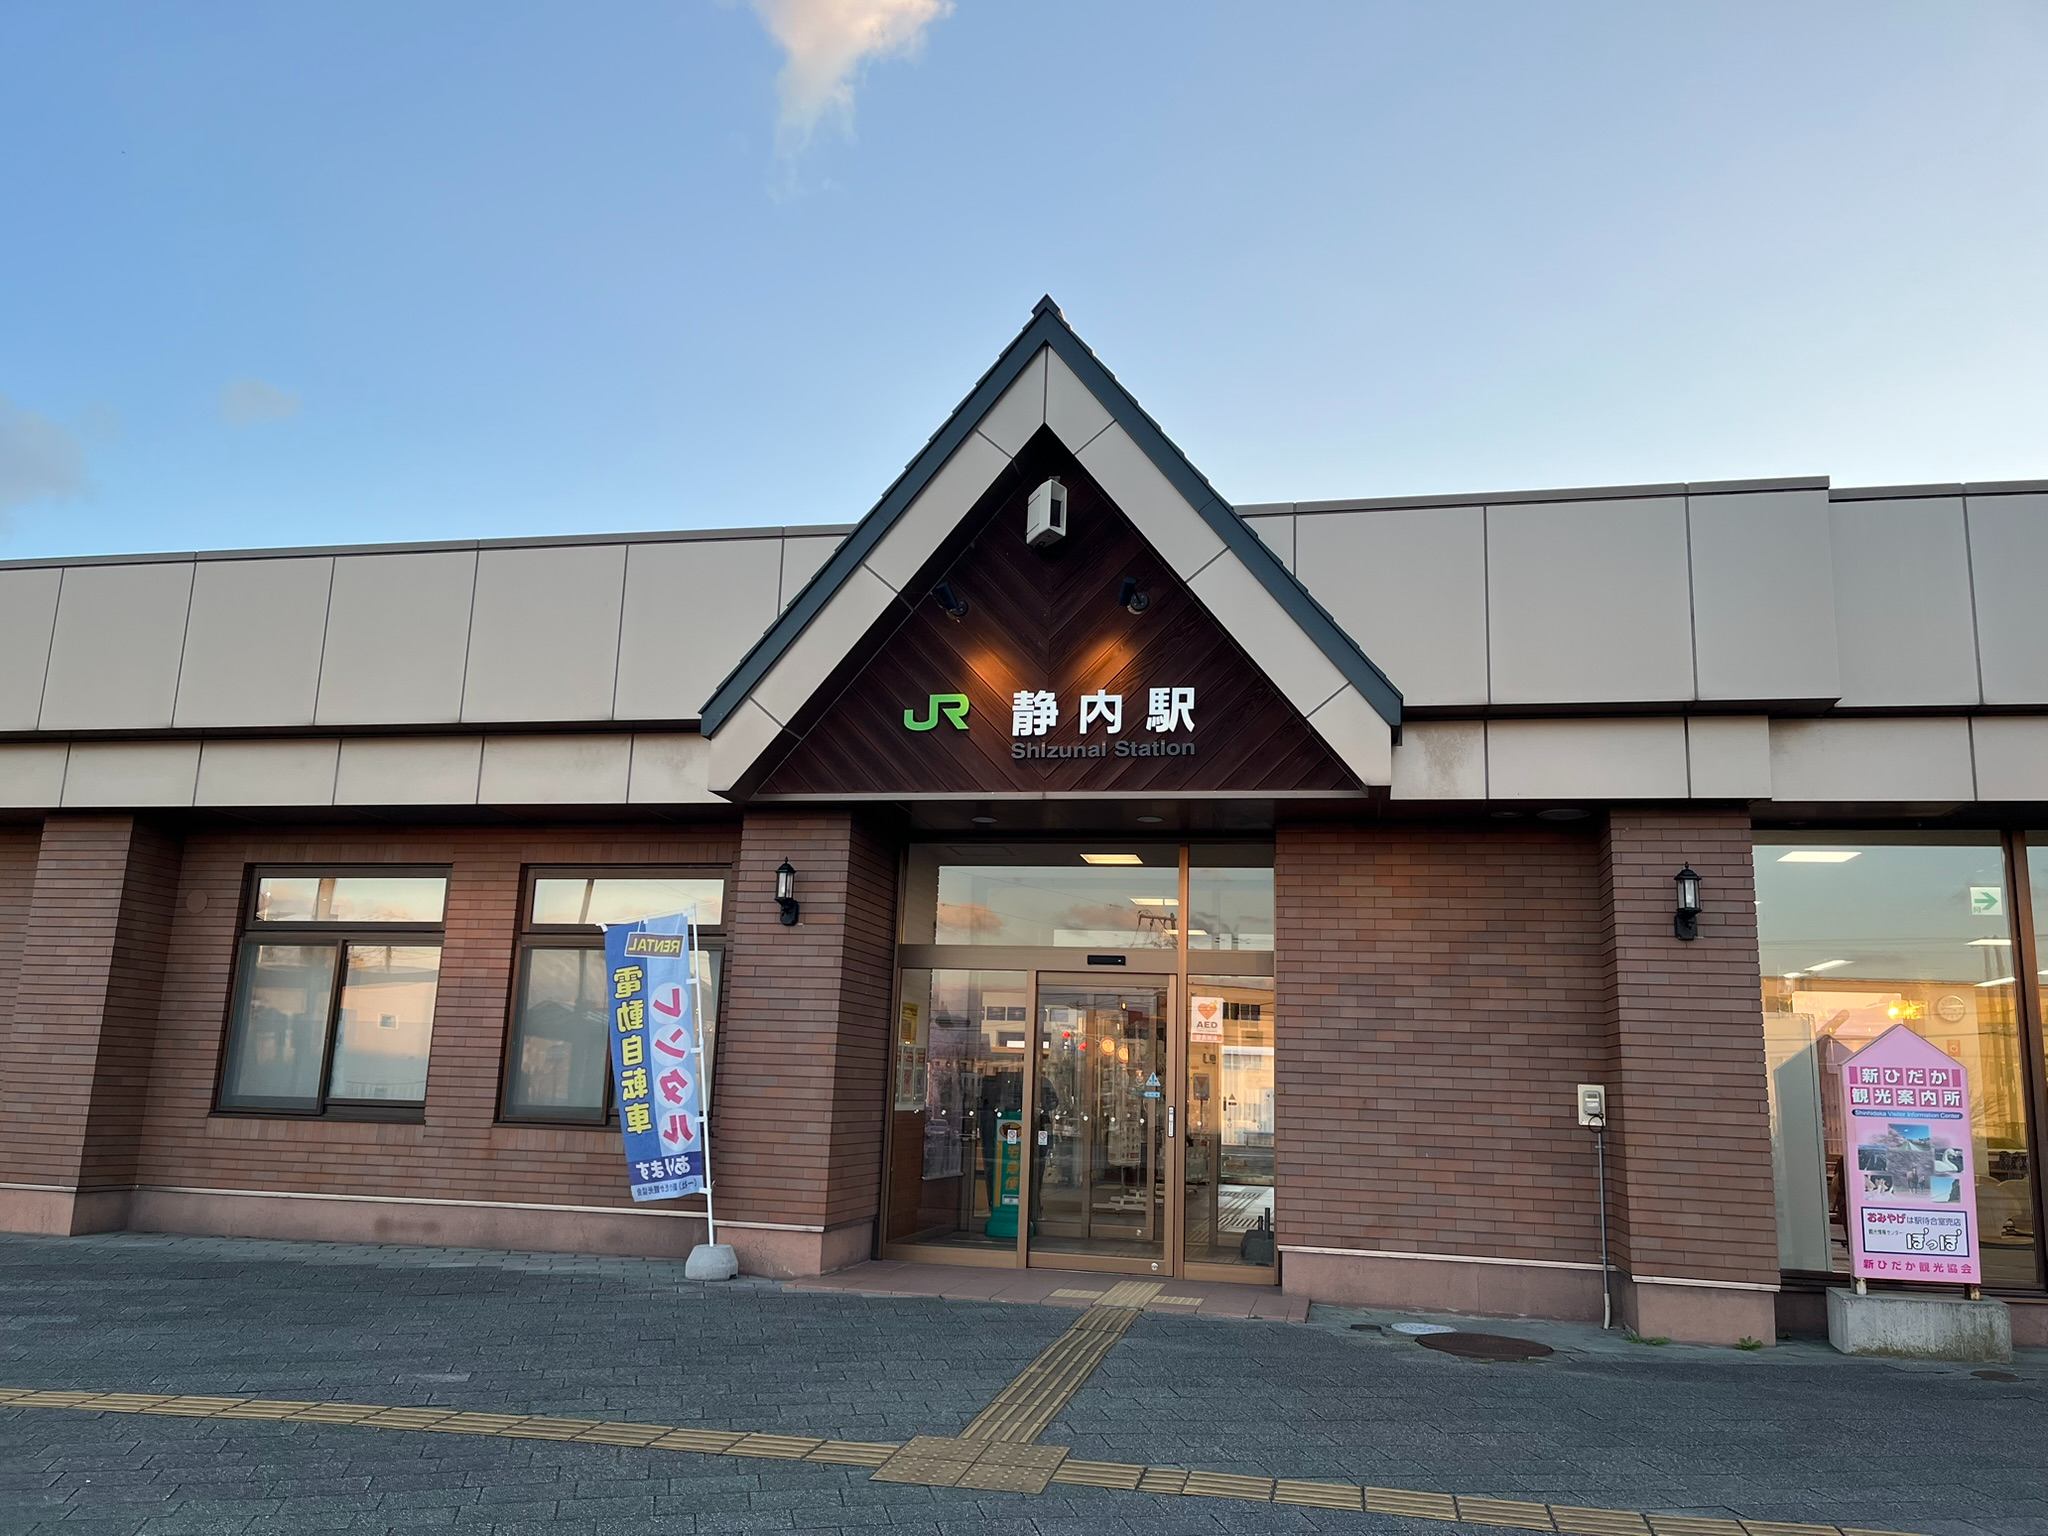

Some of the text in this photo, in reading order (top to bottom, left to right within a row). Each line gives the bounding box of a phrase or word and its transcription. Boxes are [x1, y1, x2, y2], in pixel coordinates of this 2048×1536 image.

[903, 693, 970, 731] JR
[1011, 687, 1196, 737] 静内駅
[1011, 740, 1196, 760] Shizunai Station
[1197, 1021, 1218, 1029] AED
[1861, 1068, 1947, 1085] 新ひだか
[1851, 1087, 1961, 1107] 観光案内所
[1863, 1259, 1972, 1274] 新ひだか観光協会
